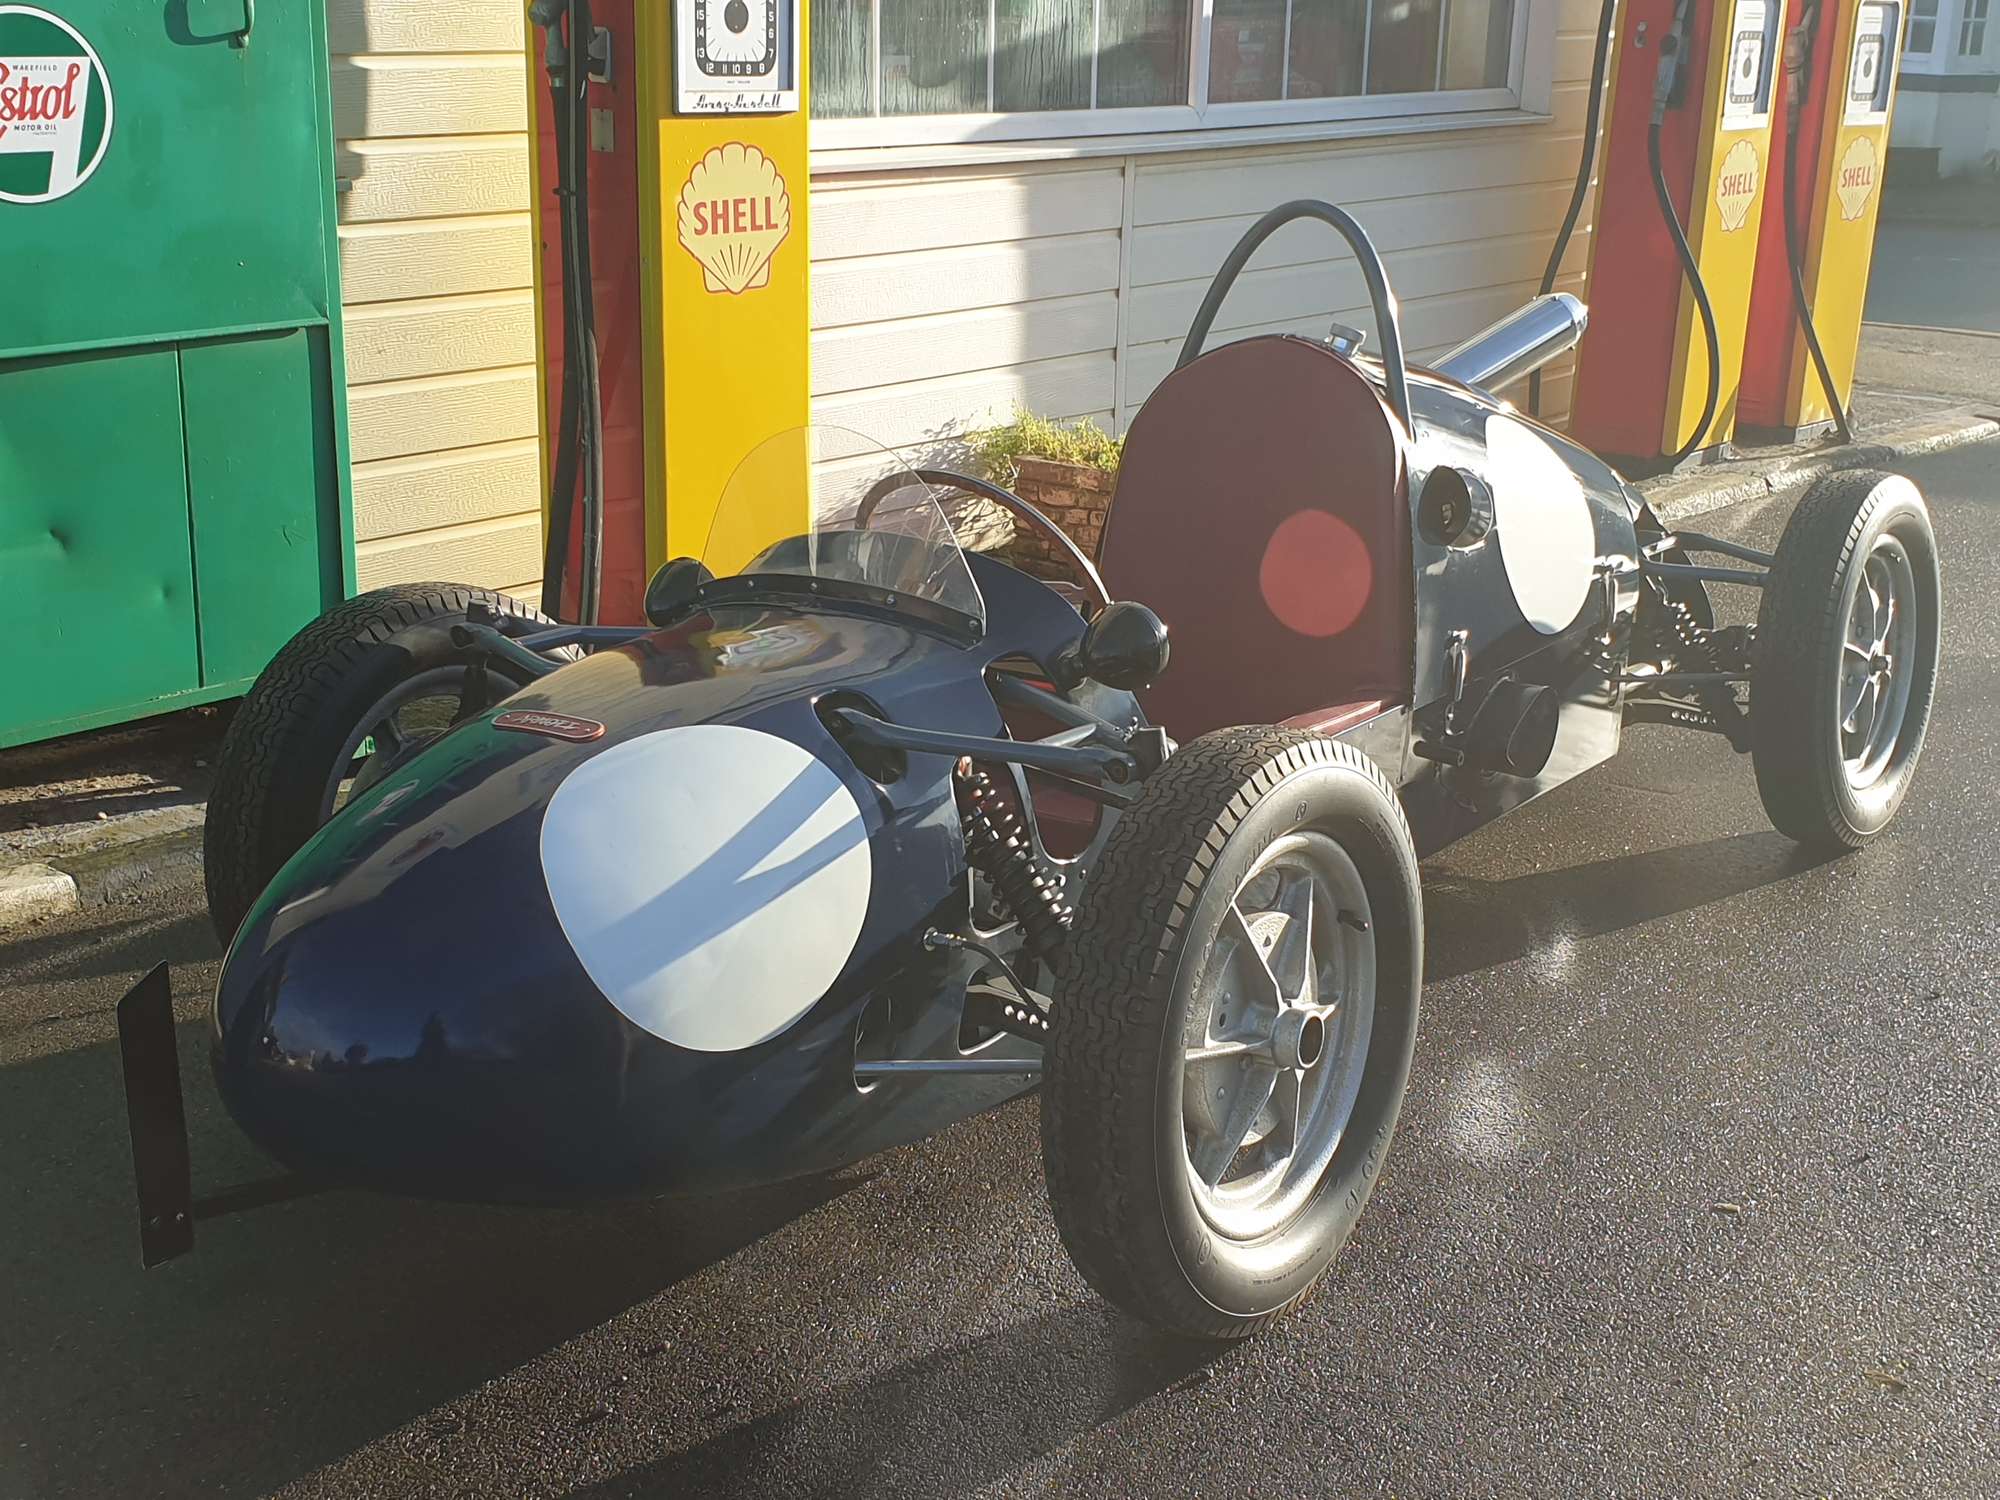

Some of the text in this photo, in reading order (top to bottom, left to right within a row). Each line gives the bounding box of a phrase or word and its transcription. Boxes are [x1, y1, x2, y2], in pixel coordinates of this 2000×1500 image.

[697, 9, 705, 20] 15
[768, 11, 775, 22] 5
[697, 27, 705, 38] 14
[768, 28, 775, 39] 6
[697, 48, 705, 58] 13
[768, 48, 774, 59] 7
[706, 63, 765, 74] 12 11 10 9 8
[0, 63, 80, 136] strol
[14, 123, 57, 132] MOTOR OIL
[1842, 166, 1872, 188] SHELL
[1721, 172, 1754, 197] SHELL
[693, 196, 778, 236] SHELL
